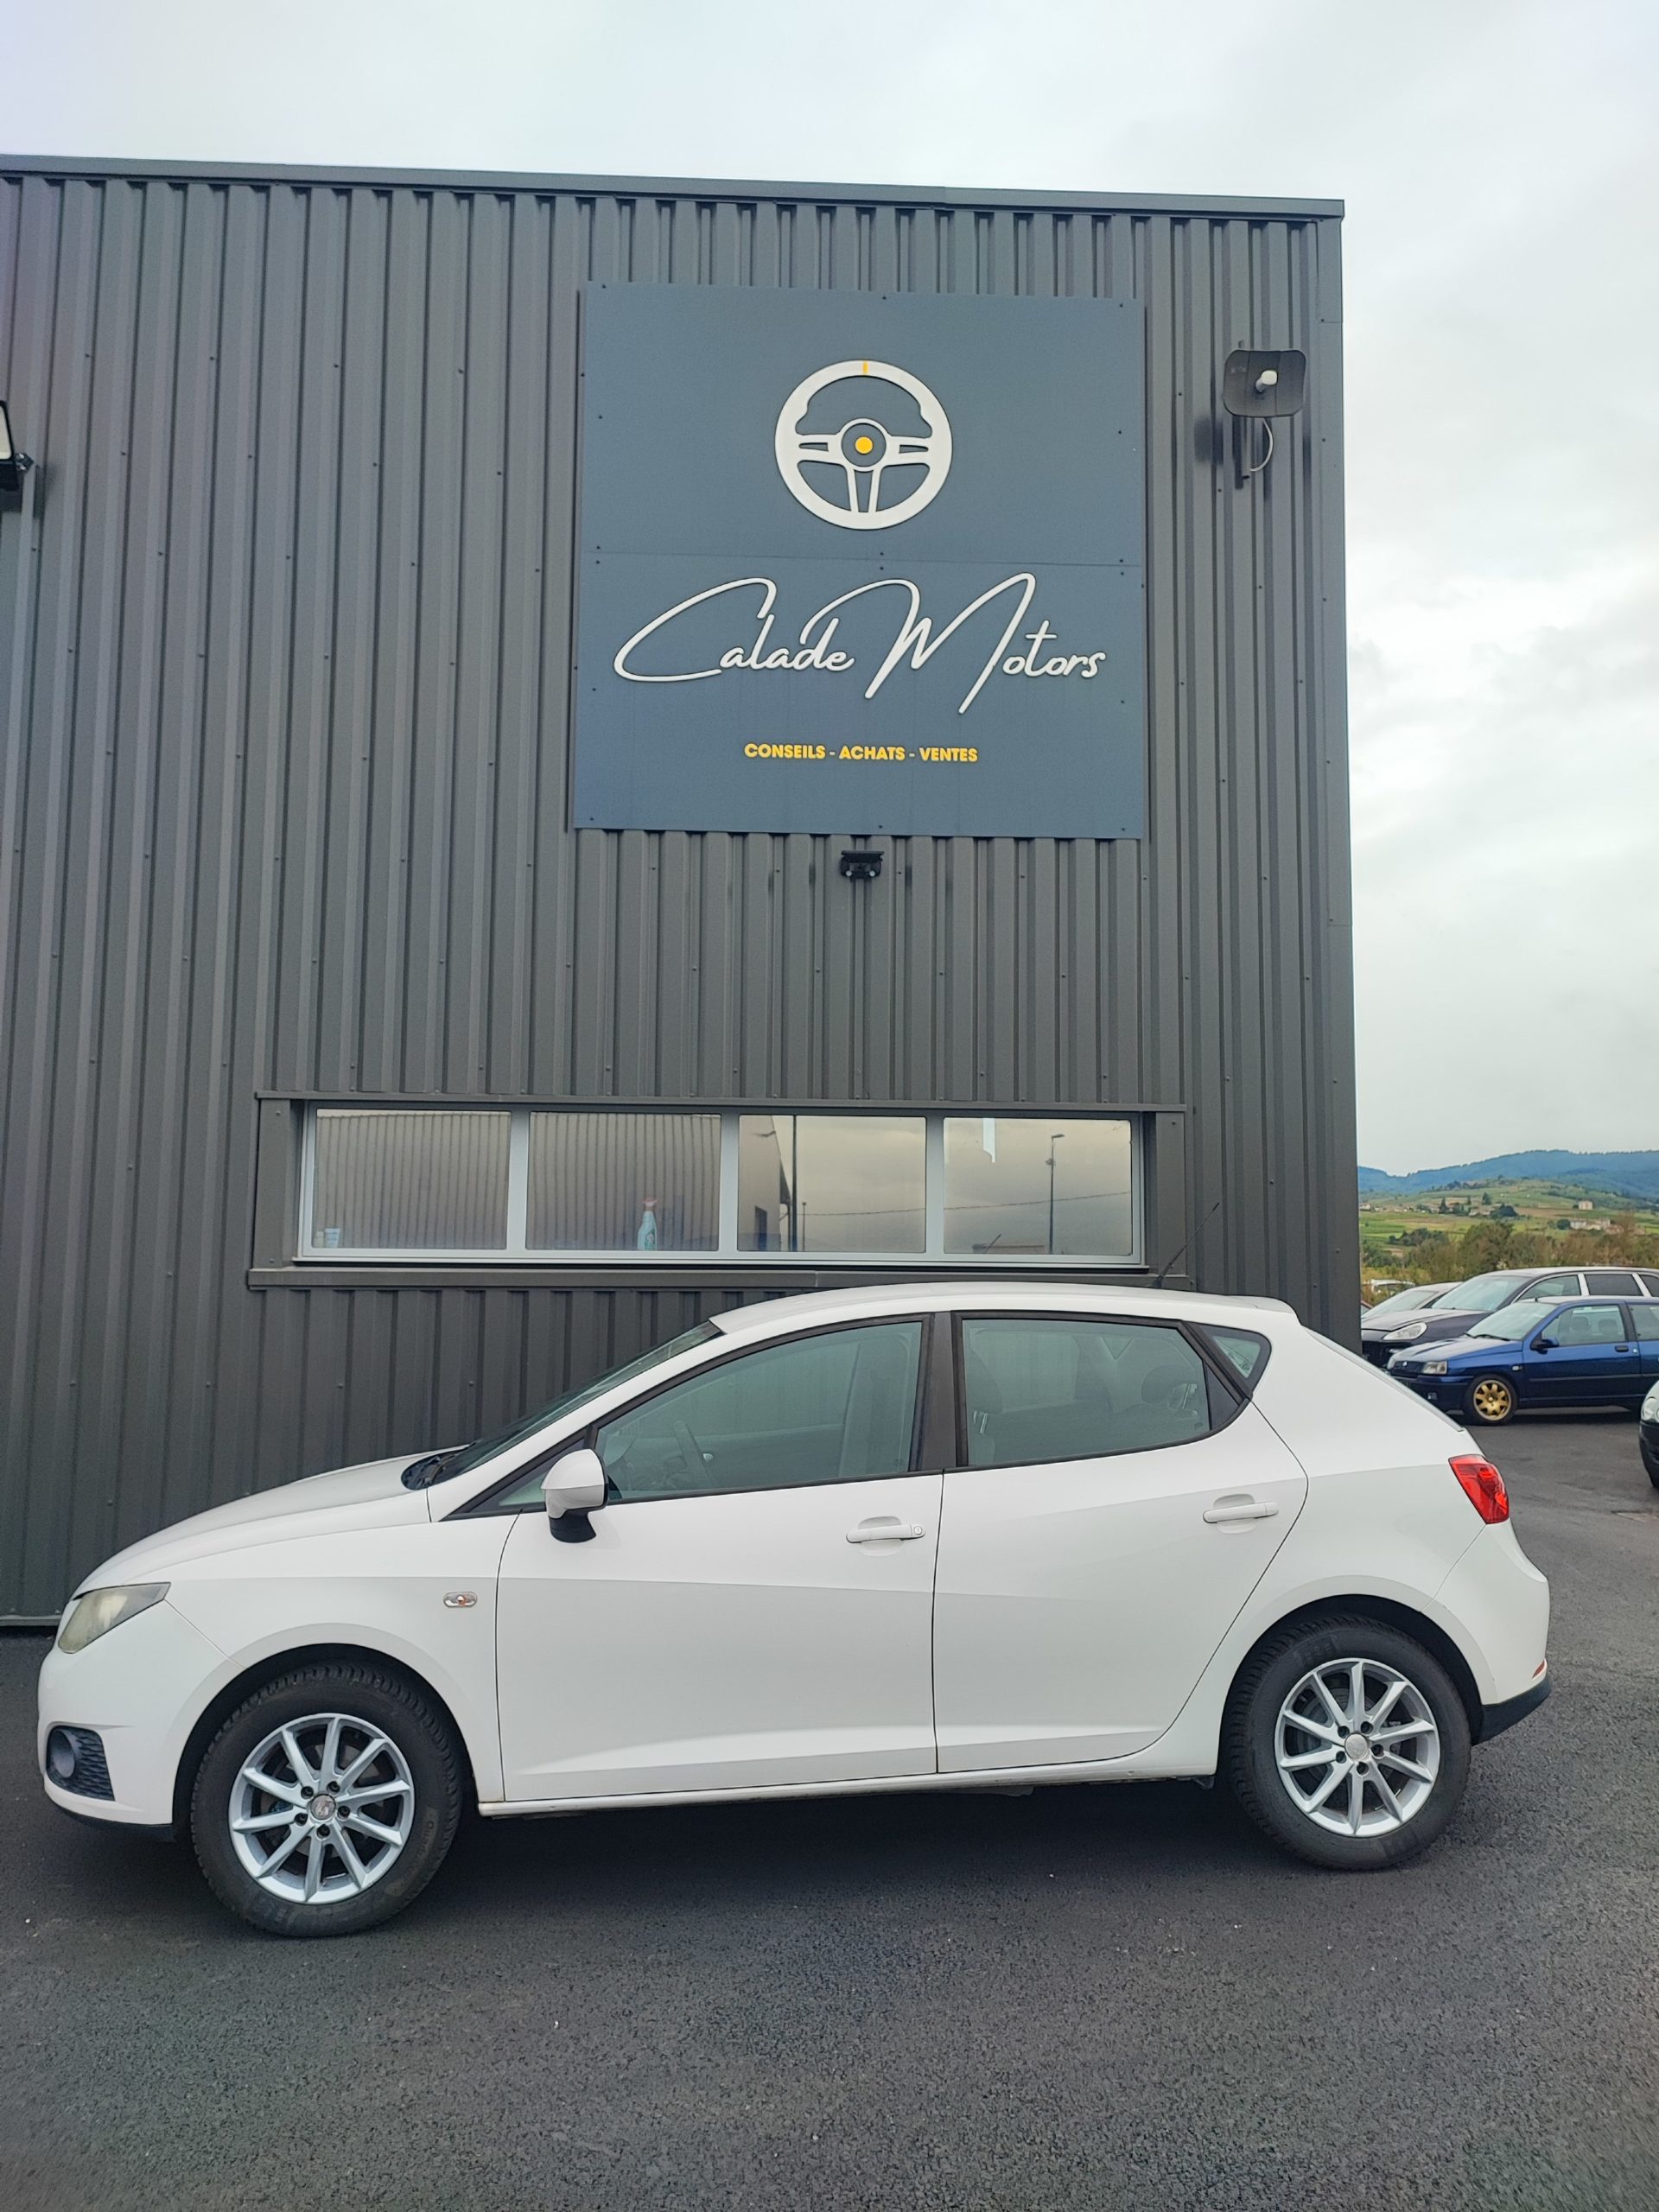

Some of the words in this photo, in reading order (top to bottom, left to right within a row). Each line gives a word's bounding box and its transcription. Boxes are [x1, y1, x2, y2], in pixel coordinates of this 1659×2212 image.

[613, 577, 855, 682] Calade
[799, 573, 1106, 714] Motors
[744, 742, 827, 760] CONSEILS
[838, 745, 906, 761] ACHATS
[918, 746, 979, 763] VENTES
